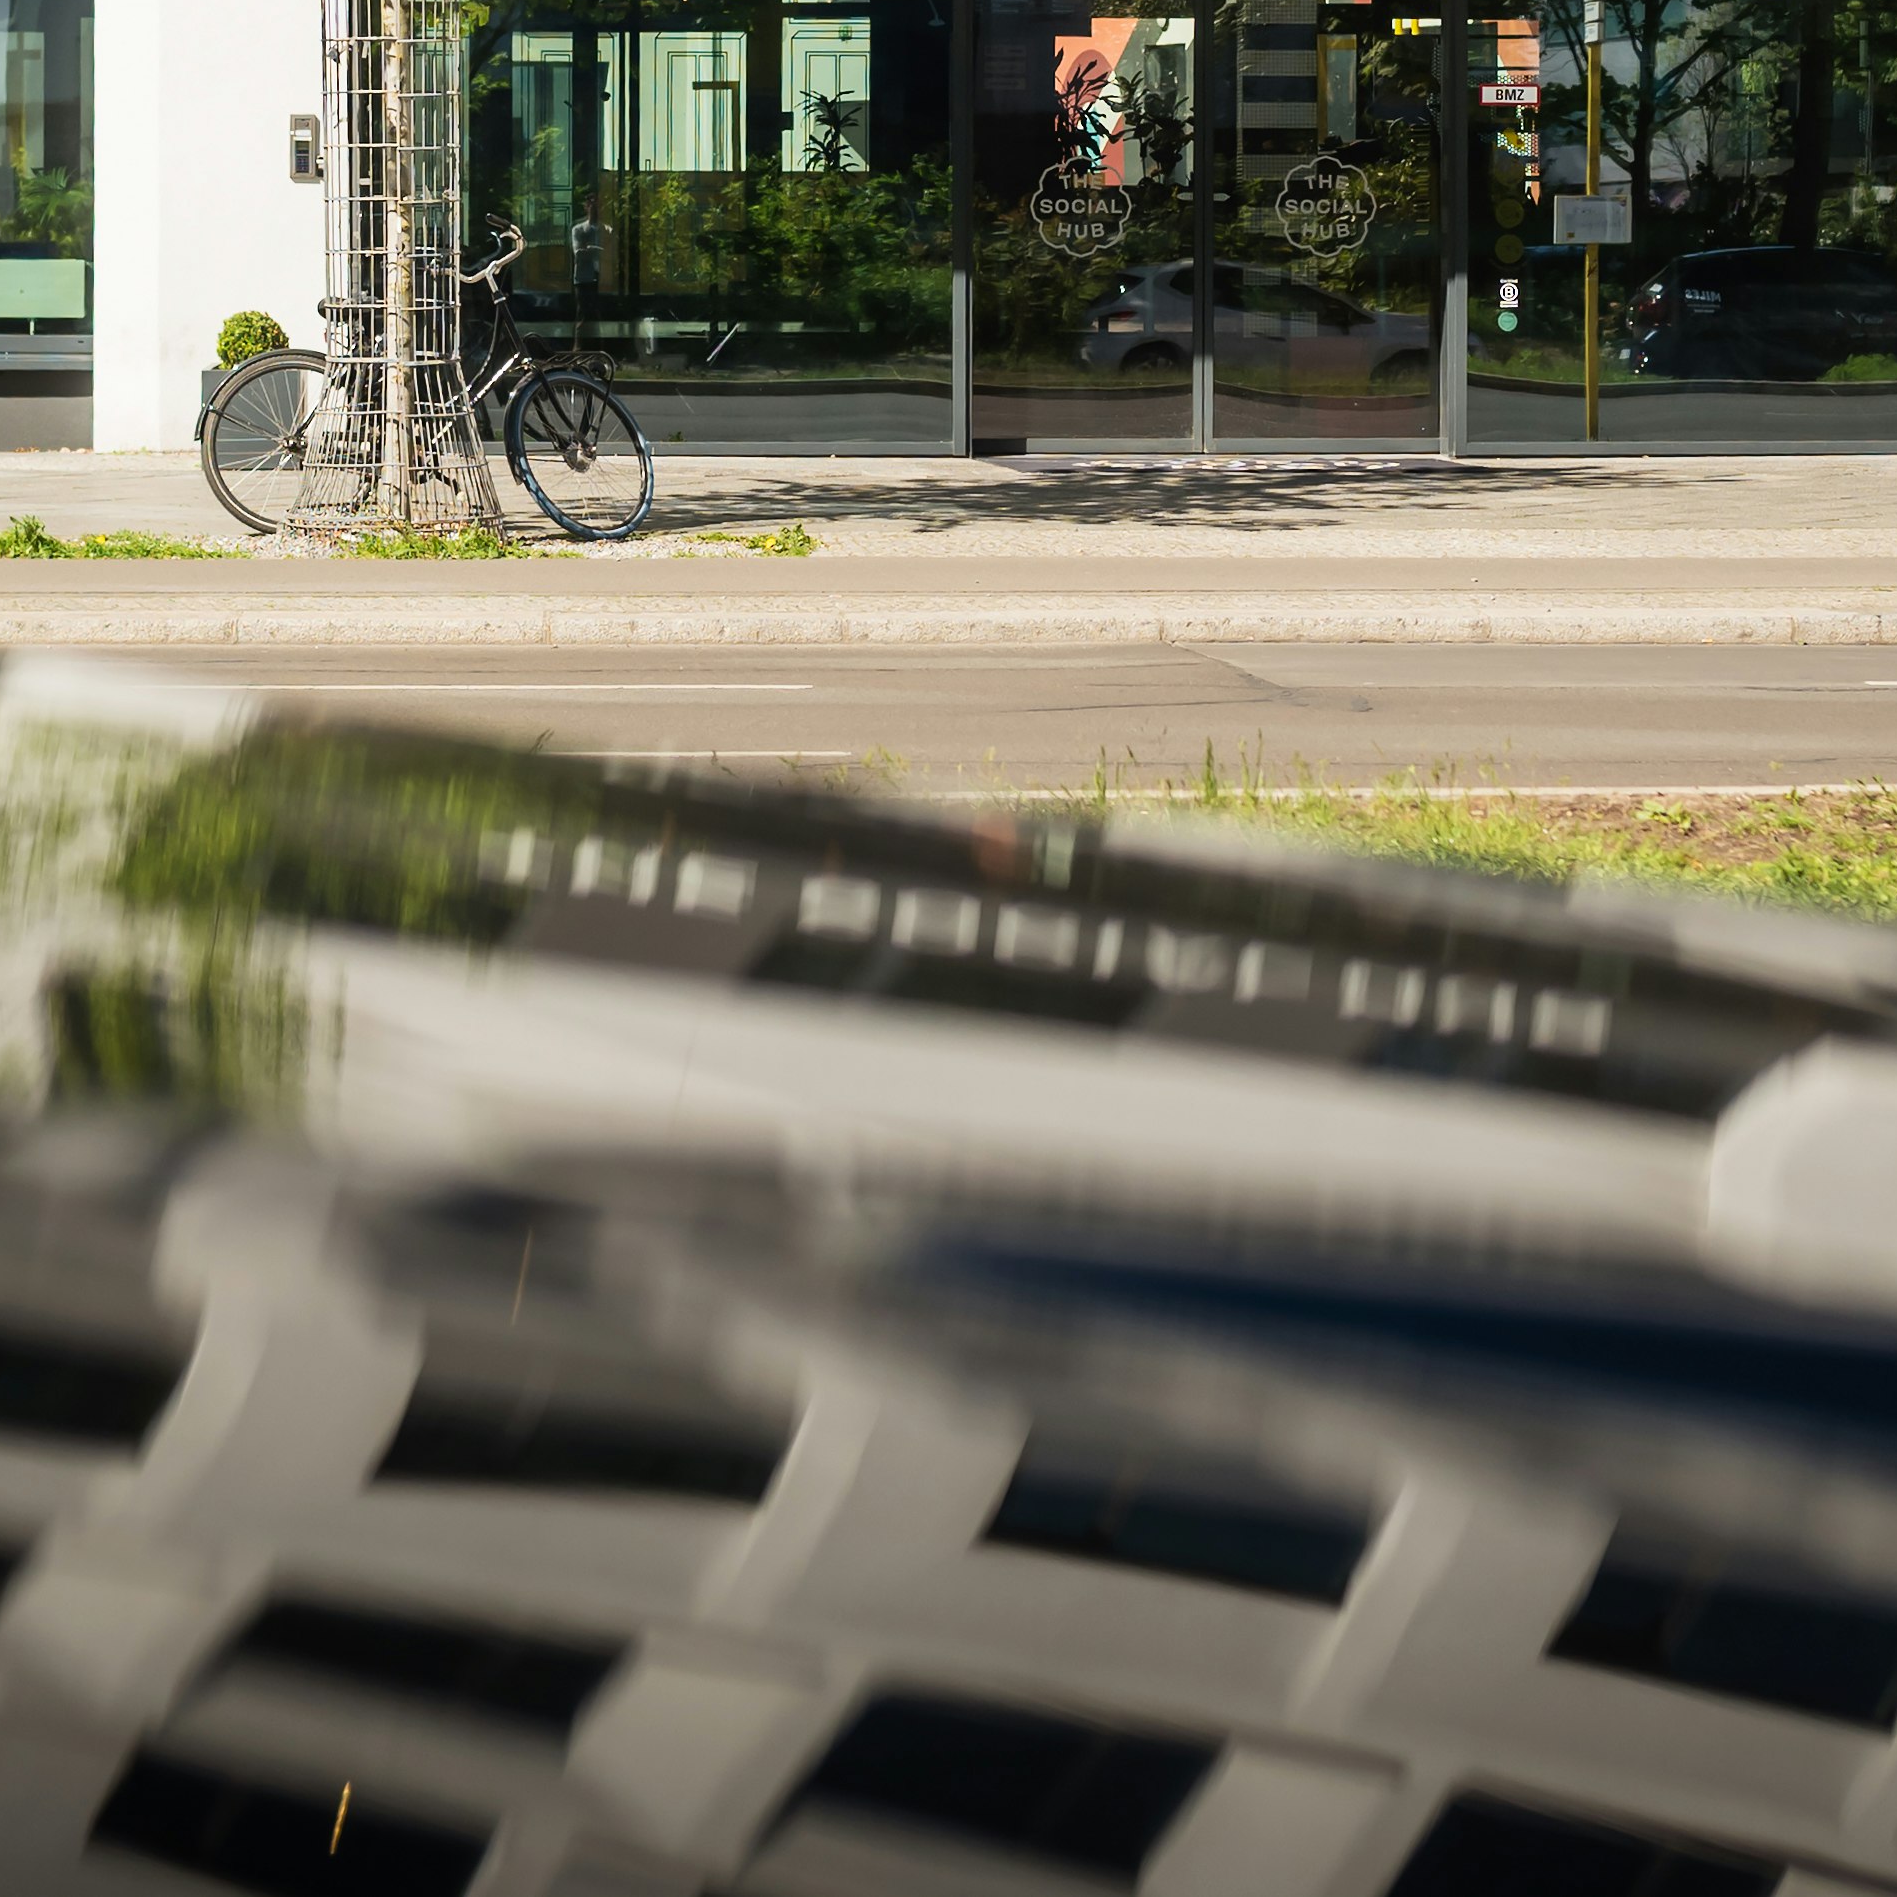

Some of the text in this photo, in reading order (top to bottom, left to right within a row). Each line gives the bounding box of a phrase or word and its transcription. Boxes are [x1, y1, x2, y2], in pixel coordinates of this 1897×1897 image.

[1495, 88, 1525, 101] BMZ
[1058, 174, 1106, 190] THE
[1303, 174, 1350, 190] THE
[1039, 198, 1123, 215] SOCIAL
[1284, 198, 1368, 215] SOCIAL
[1057, 222, 1105, 239] HUB
[1301, 222, 1351, 239] HUB
